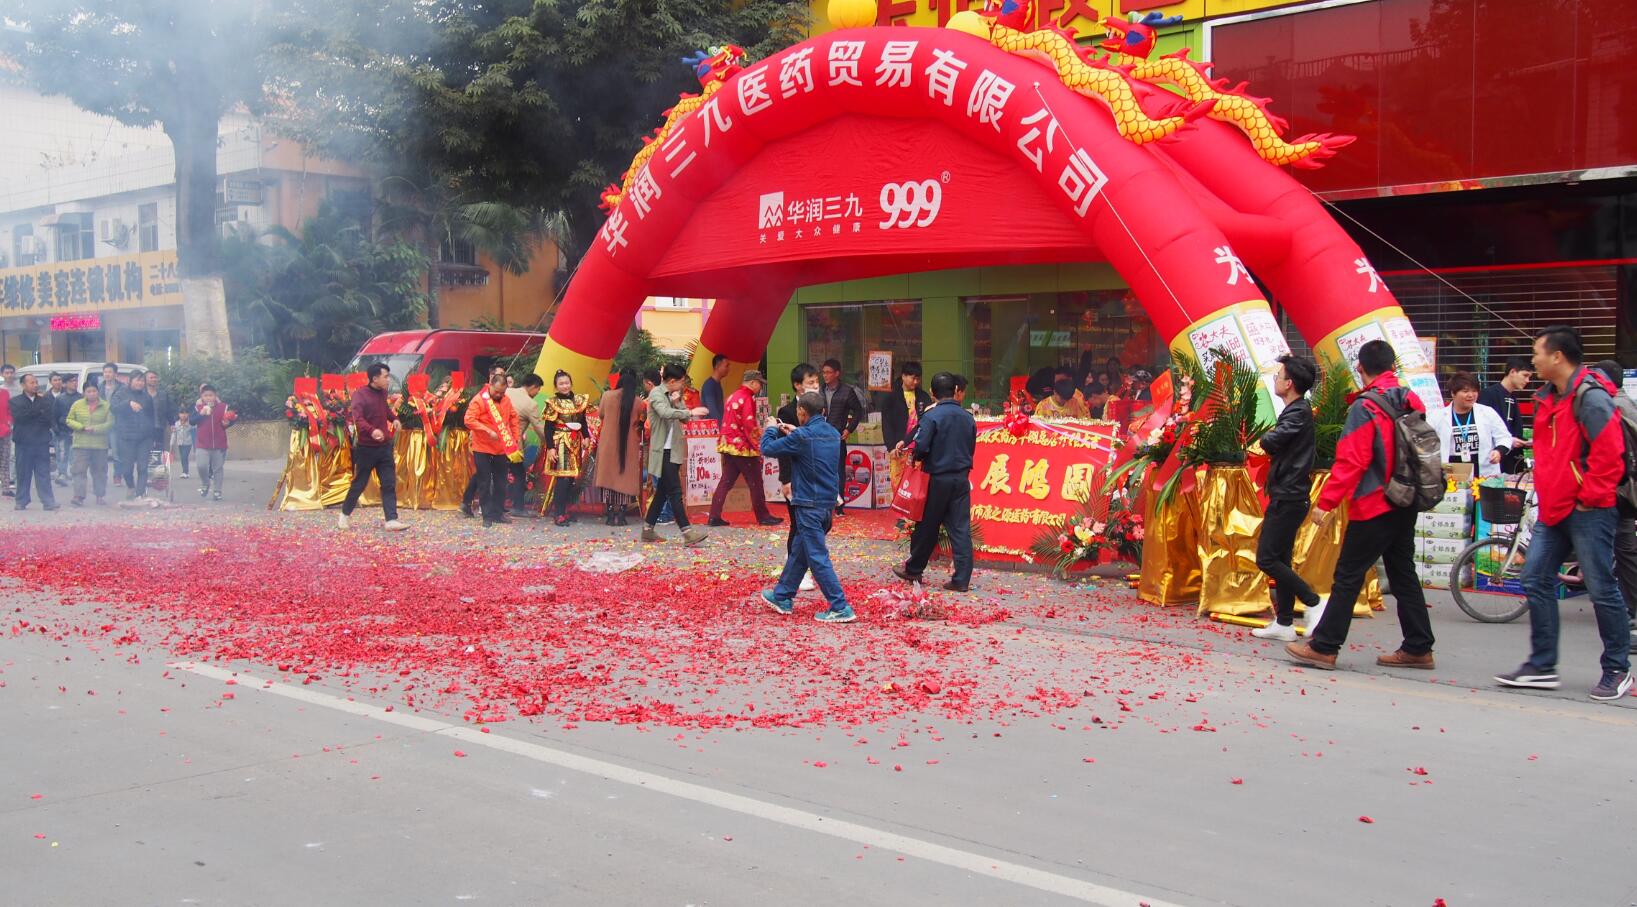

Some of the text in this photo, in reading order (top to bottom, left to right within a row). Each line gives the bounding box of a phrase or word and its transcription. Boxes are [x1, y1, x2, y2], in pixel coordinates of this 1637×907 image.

[601, 40, 1109, 254] 华润三九医药贸易有限公司
[787, 192, 863, 225] 华润三九
[879, 179, 942, 230] 999
[759, 222, 861, 244] 关爱大众健康
[0, 261, 143, 310] 维修美容连锁机构
